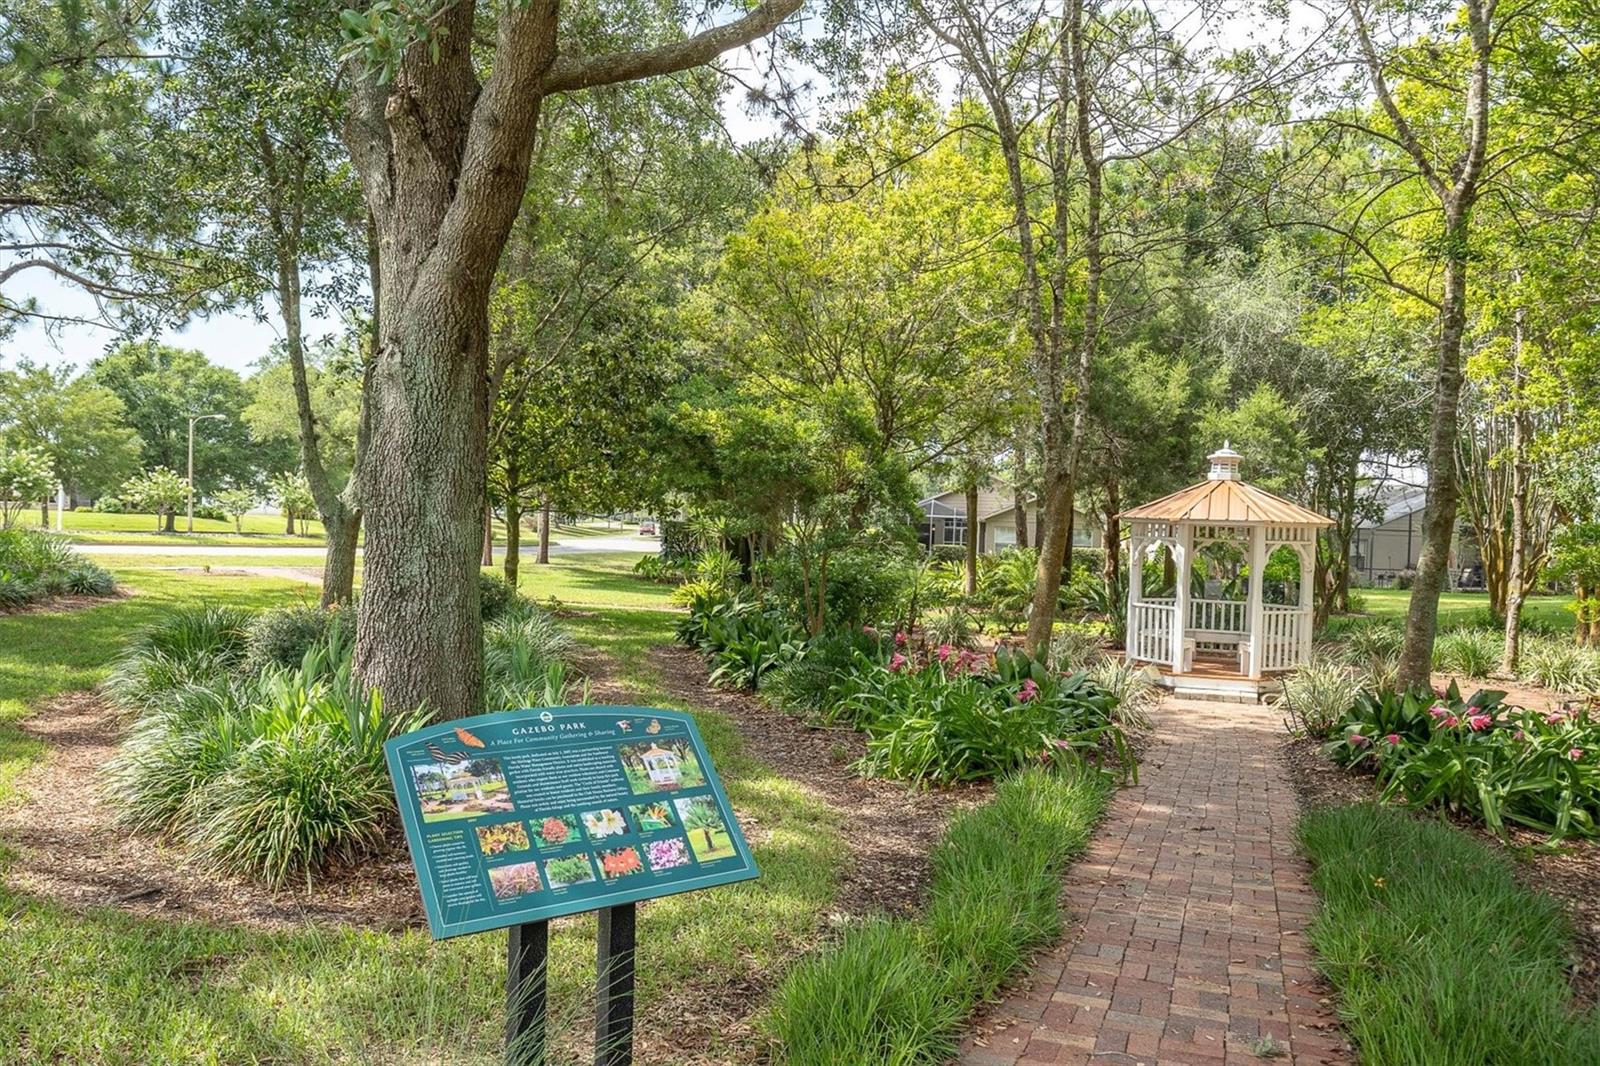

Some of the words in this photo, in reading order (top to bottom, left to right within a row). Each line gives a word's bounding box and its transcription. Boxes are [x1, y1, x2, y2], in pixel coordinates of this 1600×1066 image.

[512, 724, 555, 735] GAZEBO
[560, 722, 586, 731] PARK
[525, 735, 558, 743] Community
